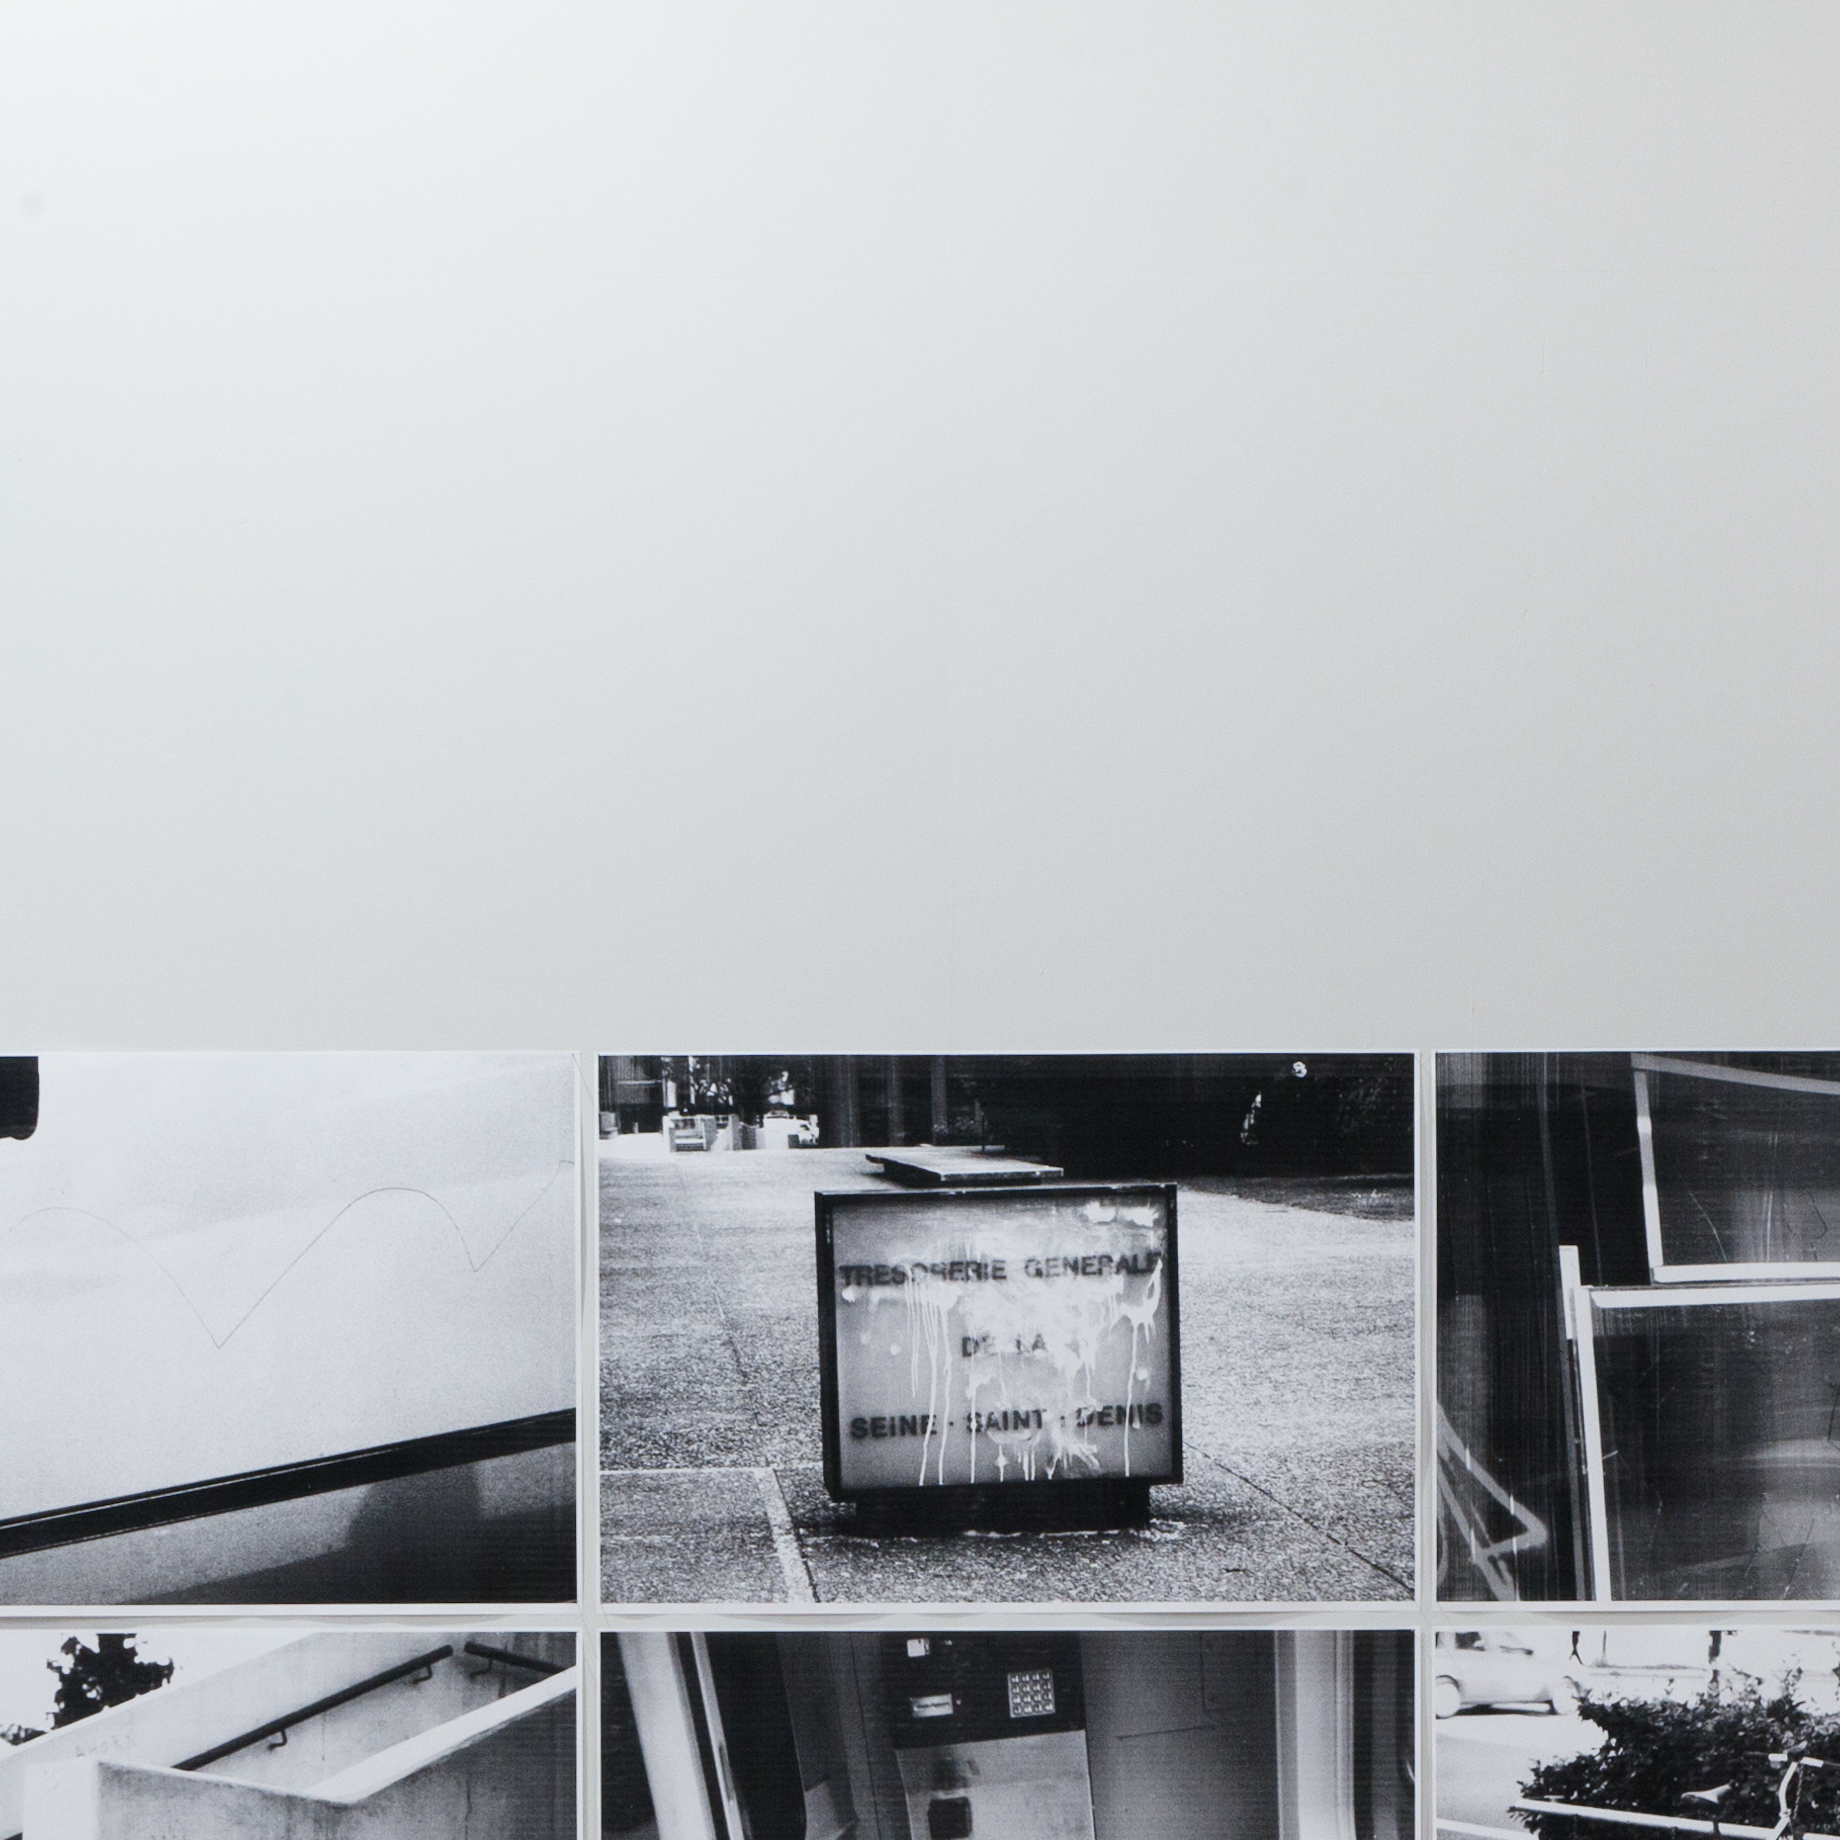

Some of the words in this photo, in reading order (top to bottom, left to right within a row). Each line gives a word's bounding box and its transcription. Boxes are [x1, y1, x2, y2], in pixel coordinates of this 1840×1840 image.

[850, 1415, 938, 1440] SEINE
[967, 1409, 1047, 1433] SAINT
[1076, 1402, 1164, 1428] DENIS
